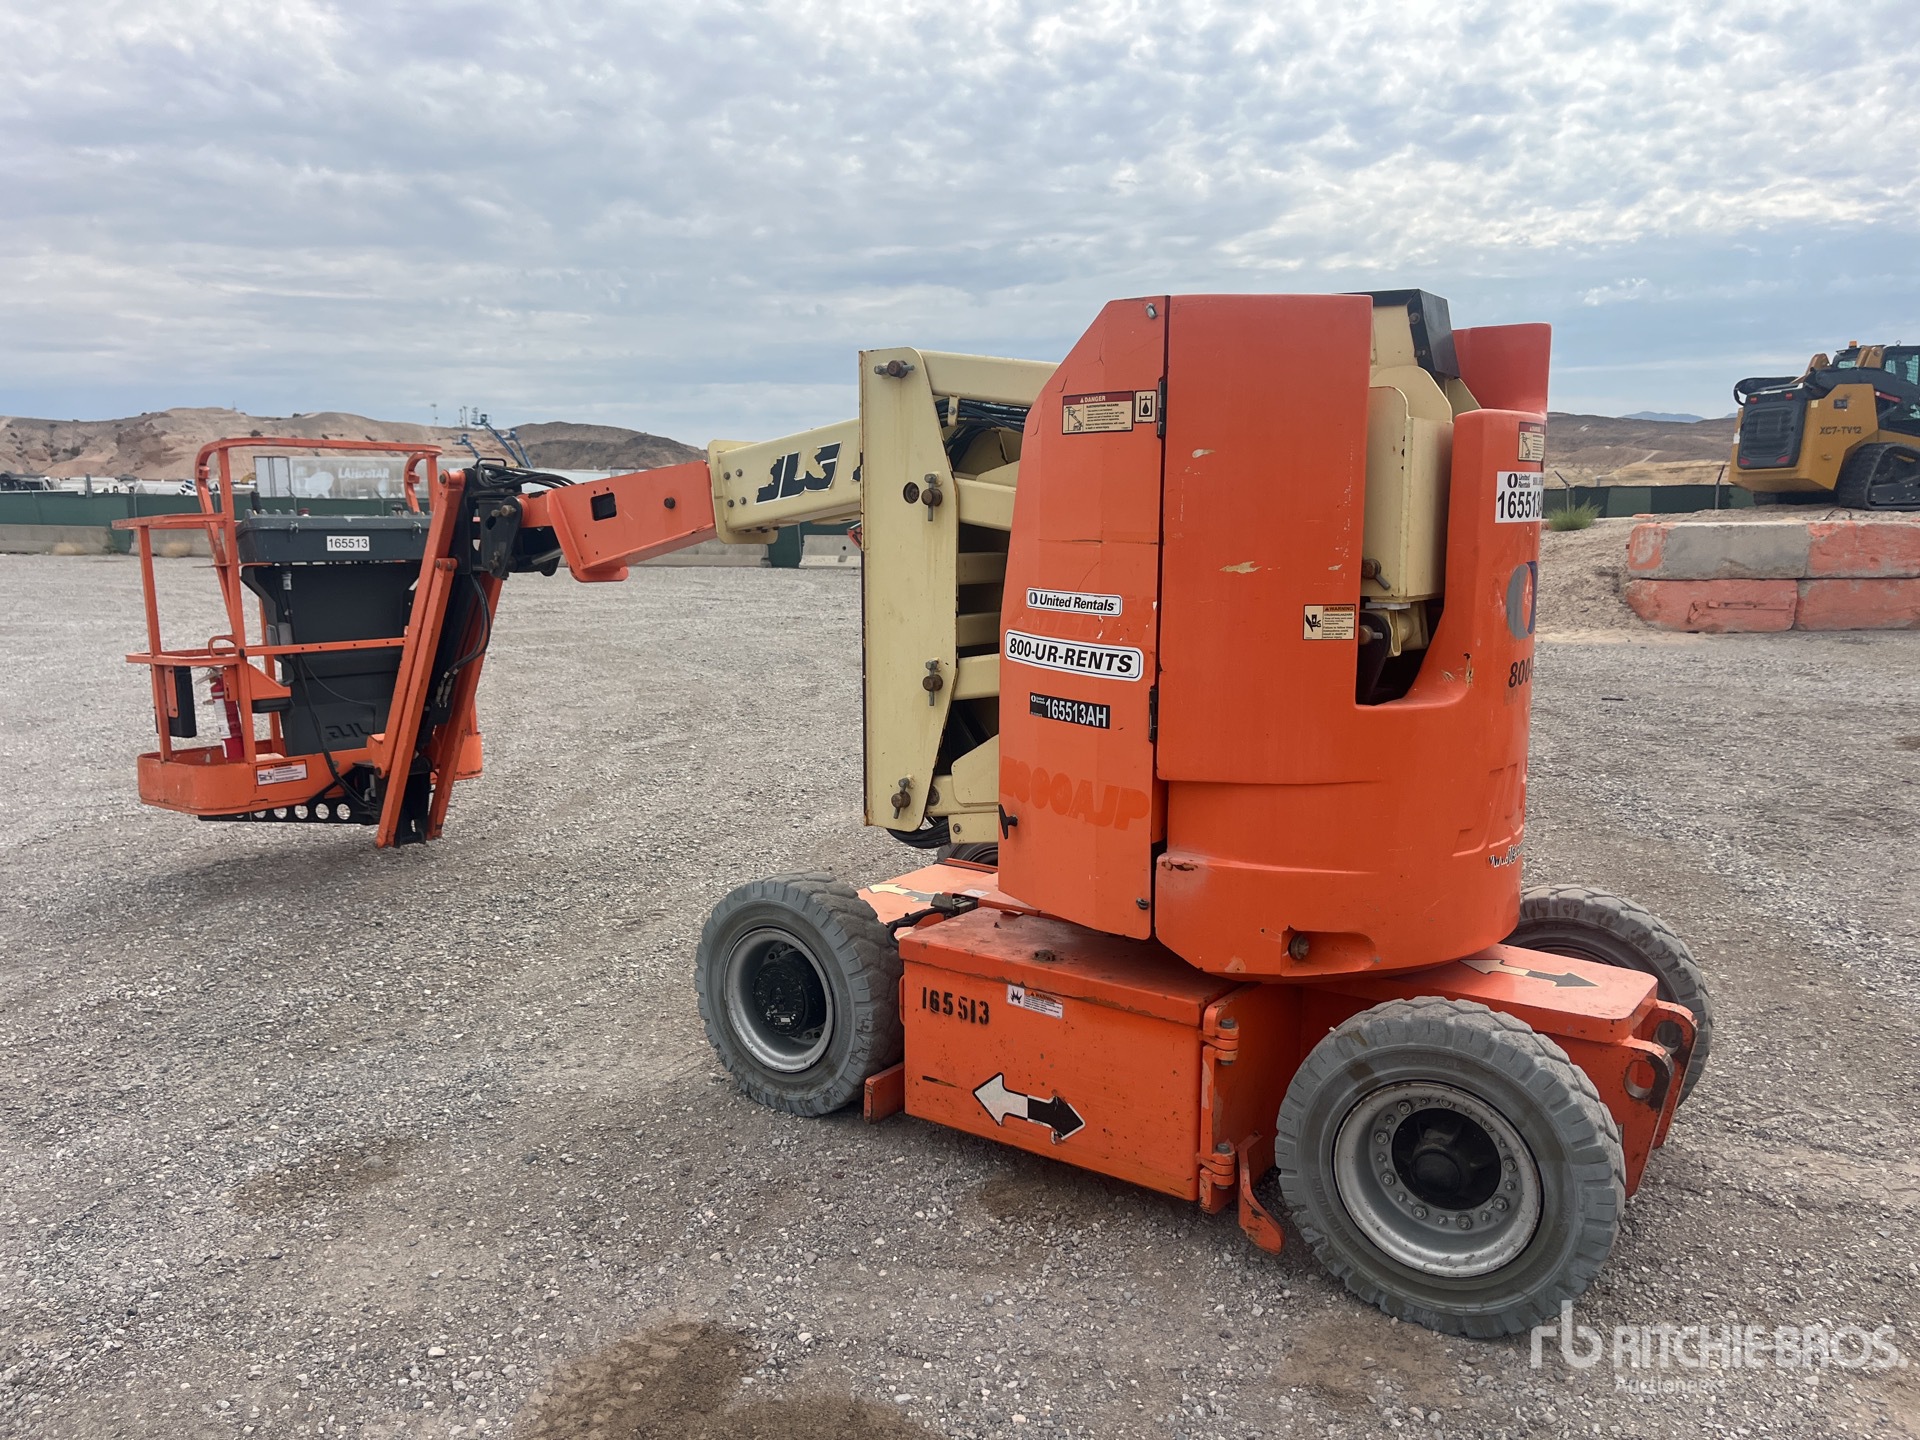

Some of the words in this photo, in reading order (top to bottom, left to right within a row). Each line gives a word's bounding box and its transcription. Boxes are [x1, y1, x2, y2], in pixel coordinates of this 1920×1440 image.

[1084, 395, 1106, 403] DANGER
[1497, 490, 1542, 519] 165513
[328, 538, 368, 549] 165513
[1039, 593, 1071, 608] United
[1073, 596, 1115, 612] Rentals
[1009, 637, 1133, 673] 800-UR-RENTS
[1045, 698, 1107, 728] 165513AH
[921, 986, 990, 1025] 165513
